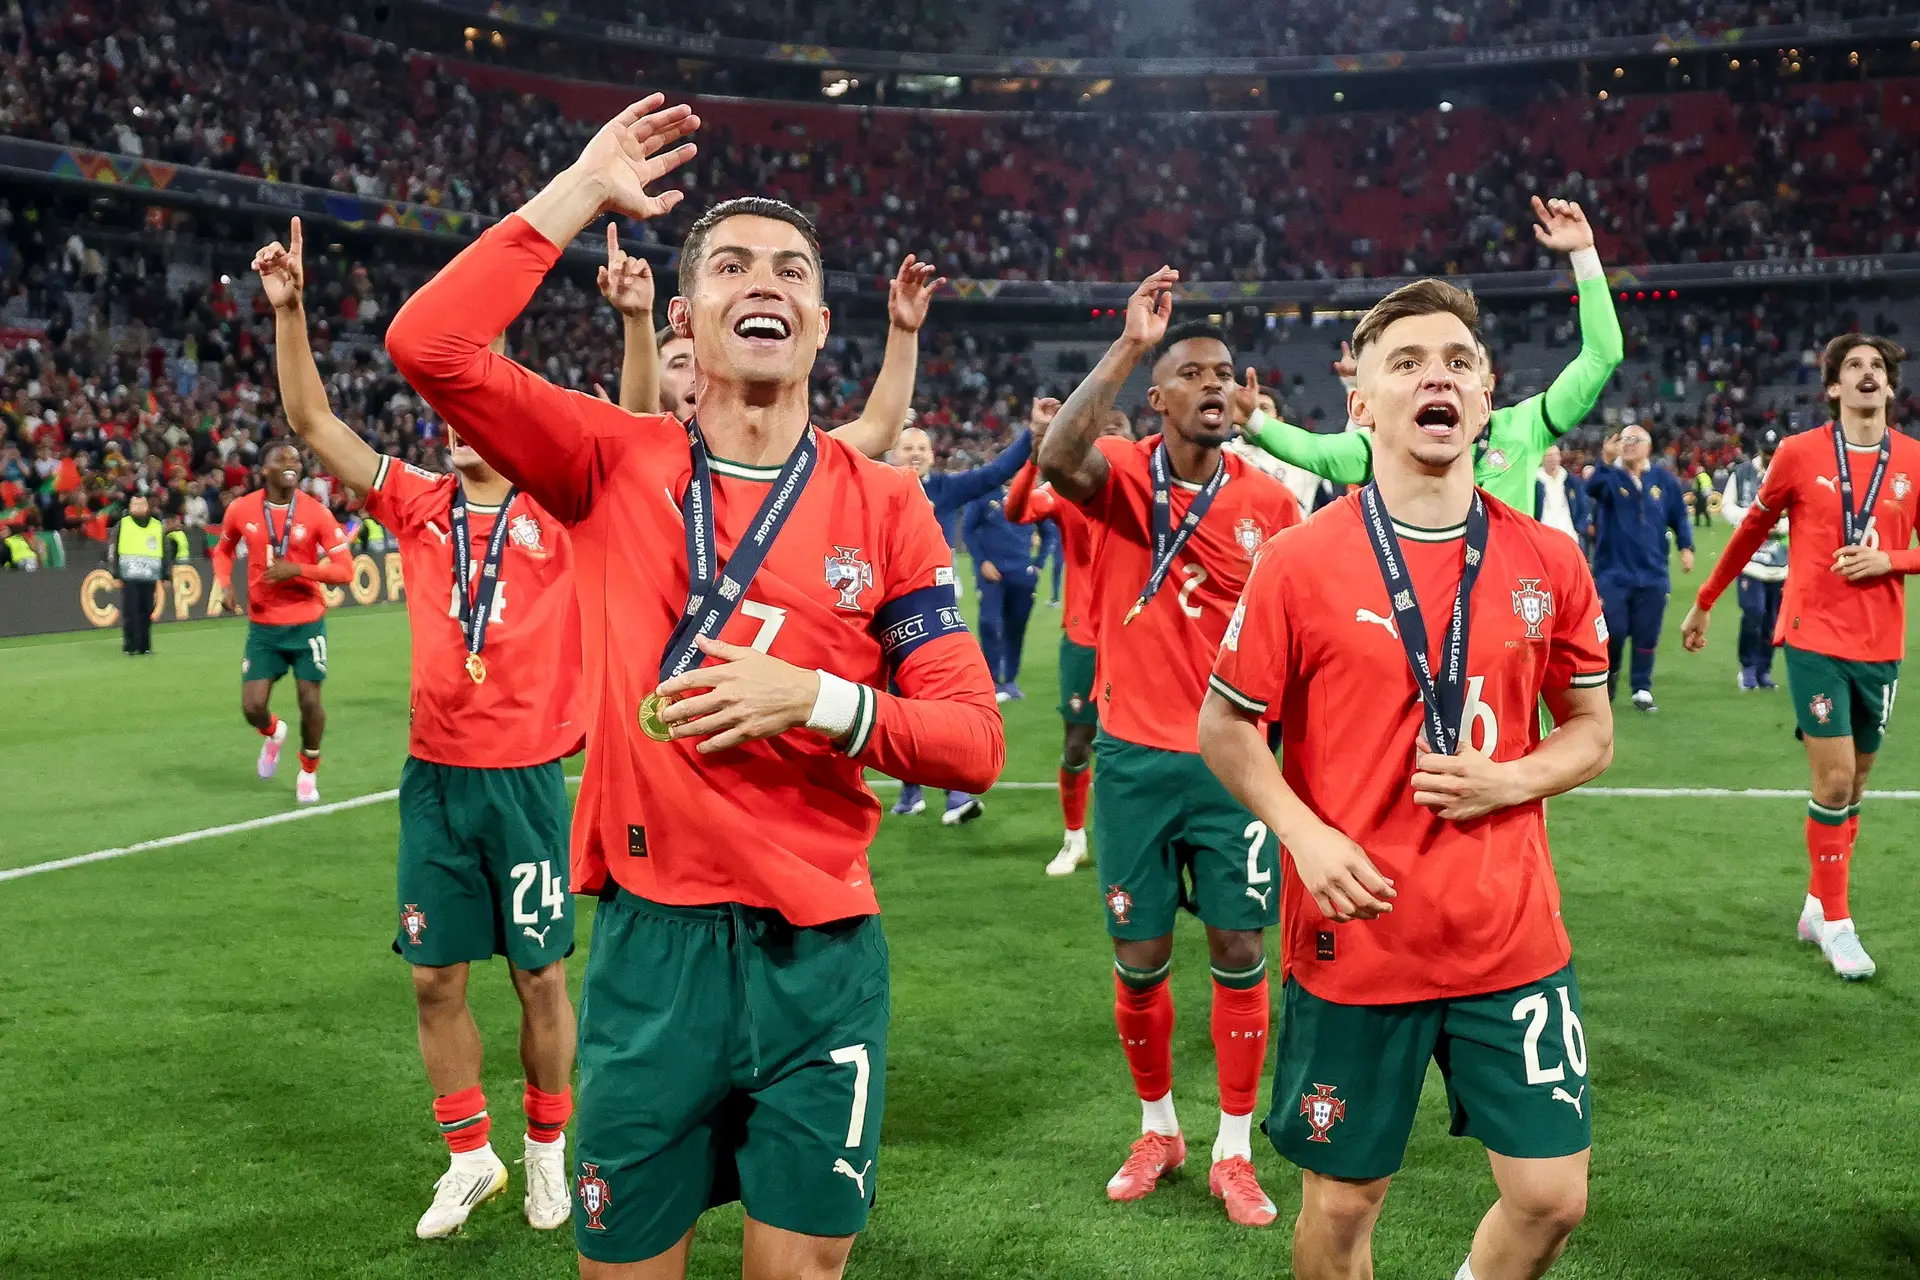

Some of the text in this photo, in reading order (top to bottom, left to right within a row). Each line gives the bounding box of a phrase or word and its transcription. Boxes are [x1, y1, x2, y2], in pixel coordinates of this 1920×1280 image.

[691, 479, 707, 580] UEFA NATIONS LEAGUE
[753, 450, 809, 547] UEFA NATIONS LEAGUE
[1367, 488, 1400, 580] UEFA NATIONS LEAGUE
[1178, 562, 1208, 618] 2
[1452, 600, 1463, 641] NATIONS
[671, 609, 720, 677] UEFA ATIONS
[740, 599, 788, 654] 7
[1448, 641, 1461, 684] LEAGUE
[1244, 820, 1271, 884] 2
[510, 860, 565, 924] 24
[1512, 986, 1587, 1085] 26
[829, 1043, 870, 1147] 7
